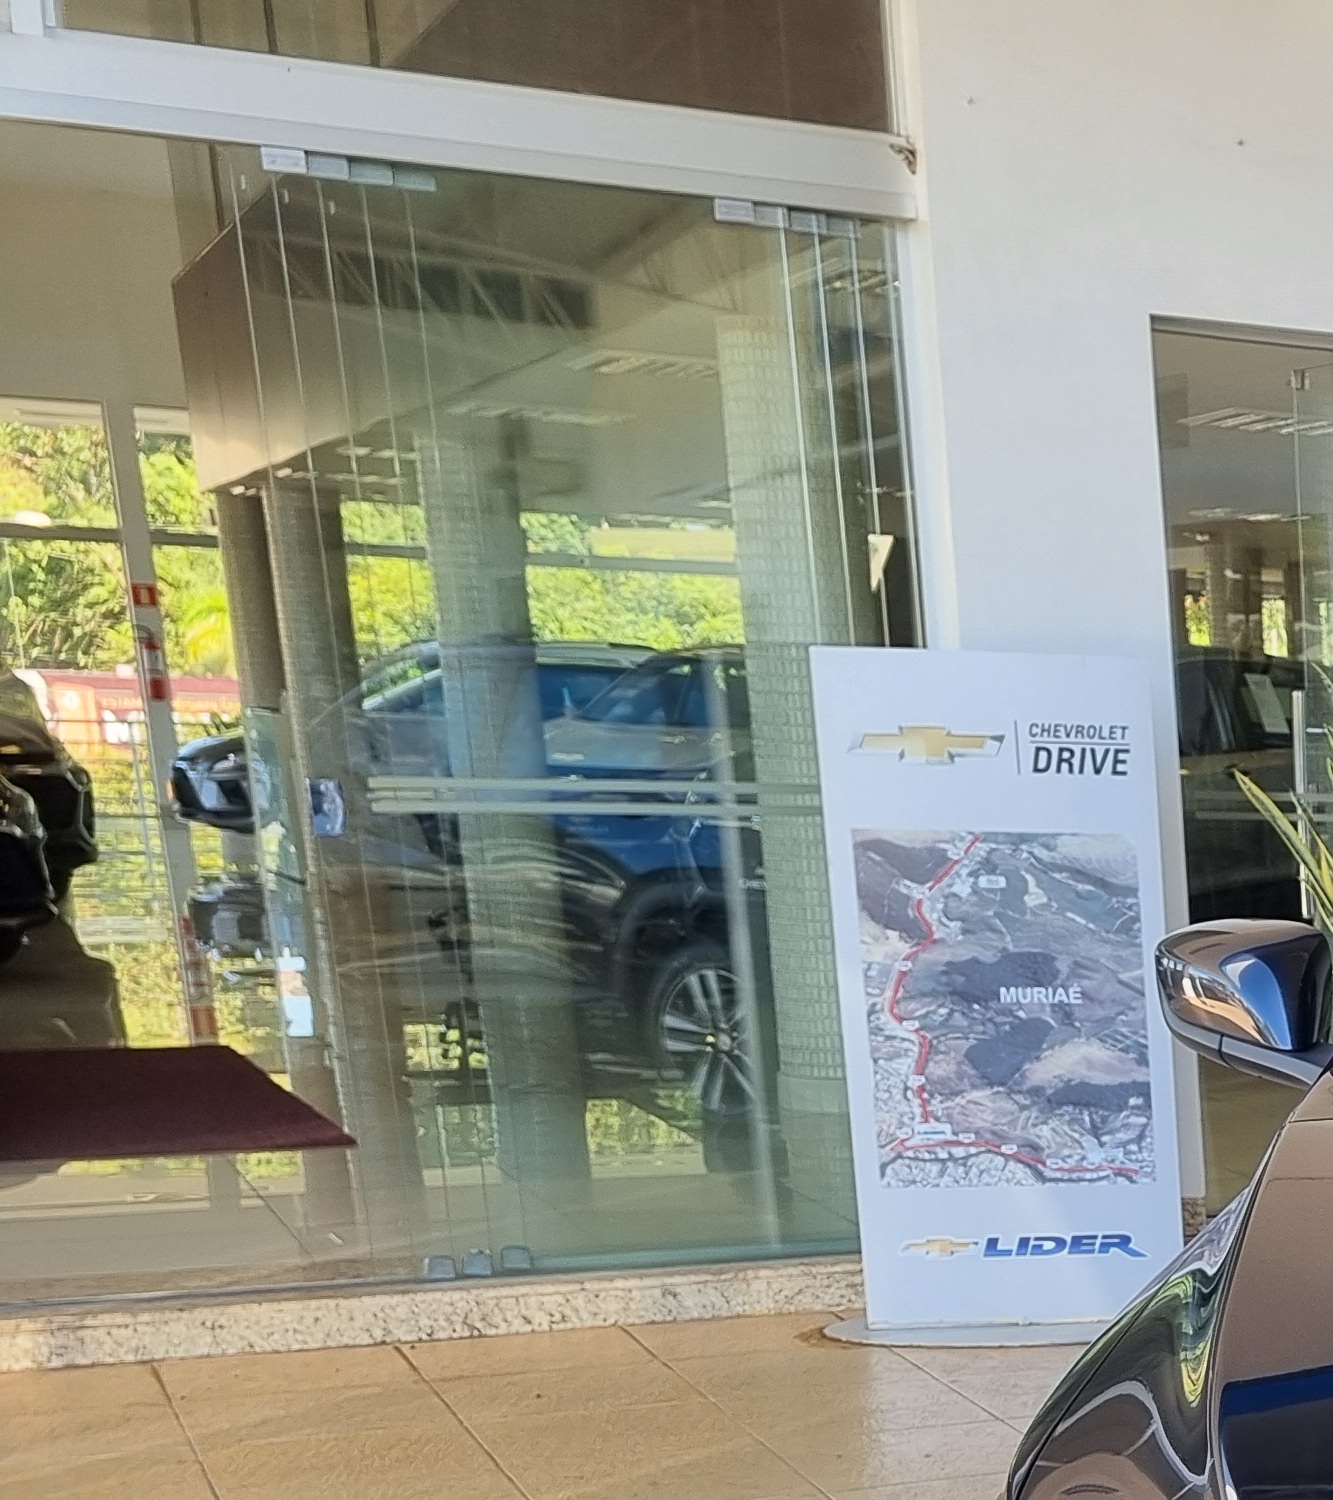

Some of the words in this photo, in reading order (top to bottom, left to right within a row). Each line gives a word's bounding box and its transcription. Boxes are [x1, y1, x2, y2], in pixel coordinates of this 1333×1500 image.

[1028, 722, 1130, 740] CHEVROLET
[1032, 746, 1131, 776] DRIVE
[999, 983, 1083, 1004] MURIAÉ
[983, 1234, 1149, 1258] LIDER
